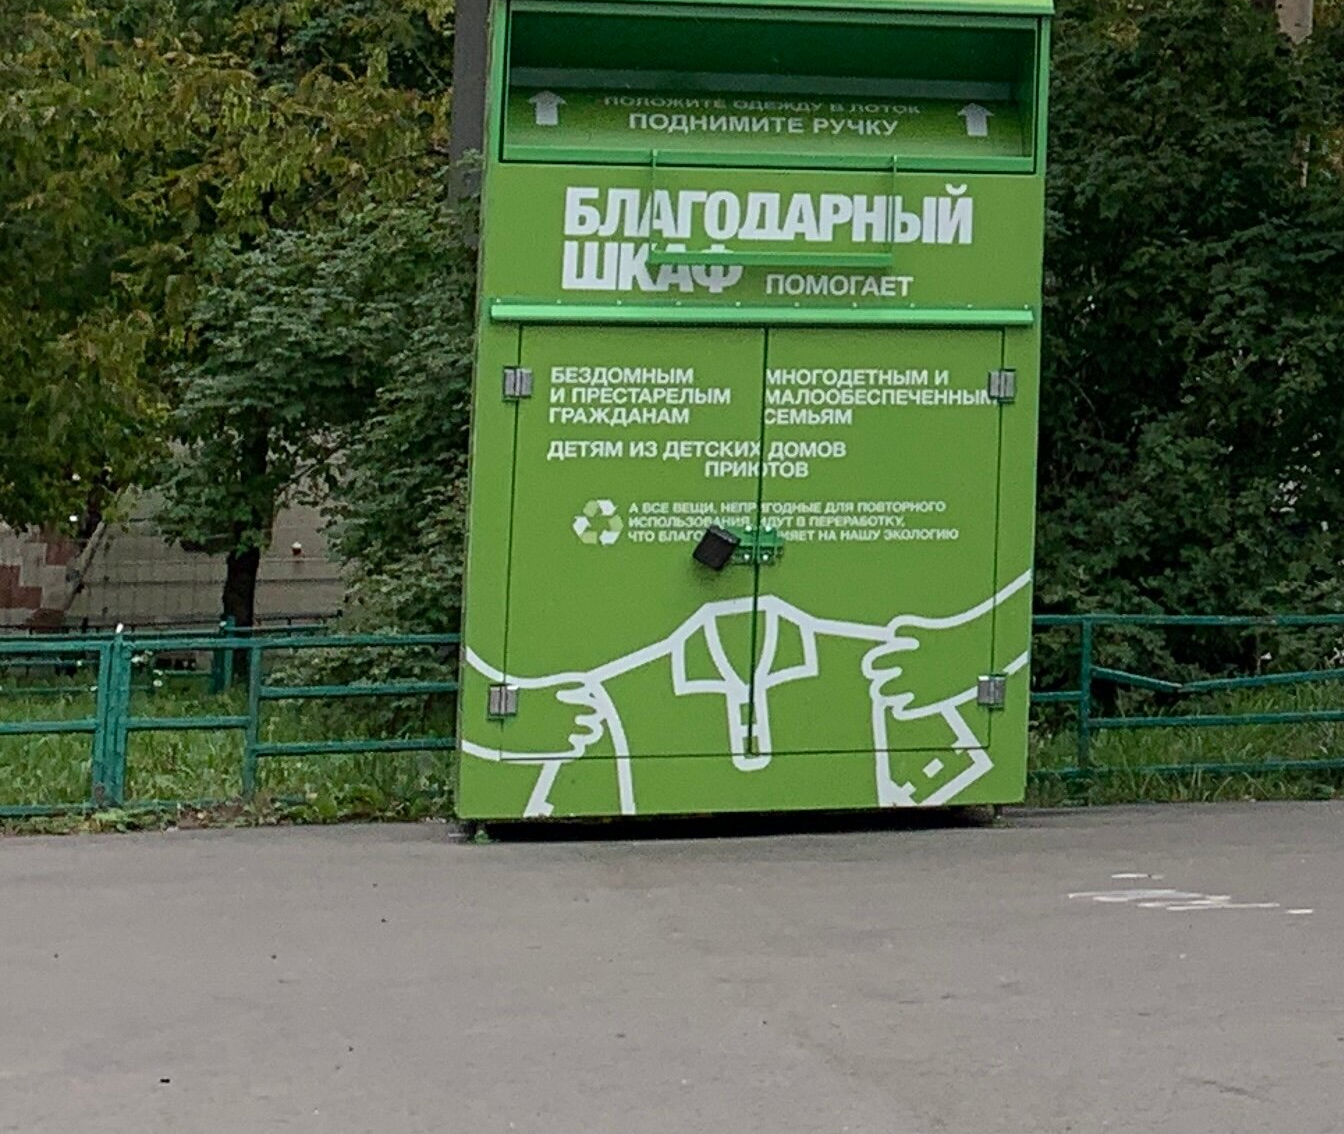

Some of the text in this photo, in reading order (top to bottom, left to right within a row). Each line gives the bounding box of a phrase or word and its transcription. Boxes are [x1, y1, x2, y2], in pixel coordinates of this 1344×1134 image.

[604, 96, 920, 114] ПОЛОЖИТЕ ОДЕЖДУ В ЛОТОК
[629, 113, 898, 136] ПОДНИМИТЕ РУЧКУ
[563, 183, 973, 244] БЛАГОДАРНЫЙ
[561, 240, 913, 296] ШКАФ ПОМОГАЕТ
[552, 367, 693, 386] БЕЗДОМНЫМ
[766, 368, 948, 388] МНОГОДЕТНЫМ И
[550, 387, 730, 404] И ПРЕСТАРЕЛЫМ
[550, 408, 689, 426] ГРАЖДАНАМ
[765, 408, 852, 424] СЕМЬЯМ
[547, 441, 846, 460] ДЕТЯМ ИЗ ДЕТСКИХ ДОМОВ
[705, 461, 808, 477] ПРИЮТОВ
[629, 503, 638, 513] А
[642, 503, 668, 514] ВСЕ
[824, 502, 854, 514] ДЛЯ
[858, 501, 945, 512] ПОВТОРНОГО
[797, 517, 806, 527] В
[628, 531, 655, 541] ЧТО
[819, 530, 836, 540] НА
[840, 530, 880, 540] НАШУ
[884, 529, 959, 540] ЭКОЛОГИЮ
